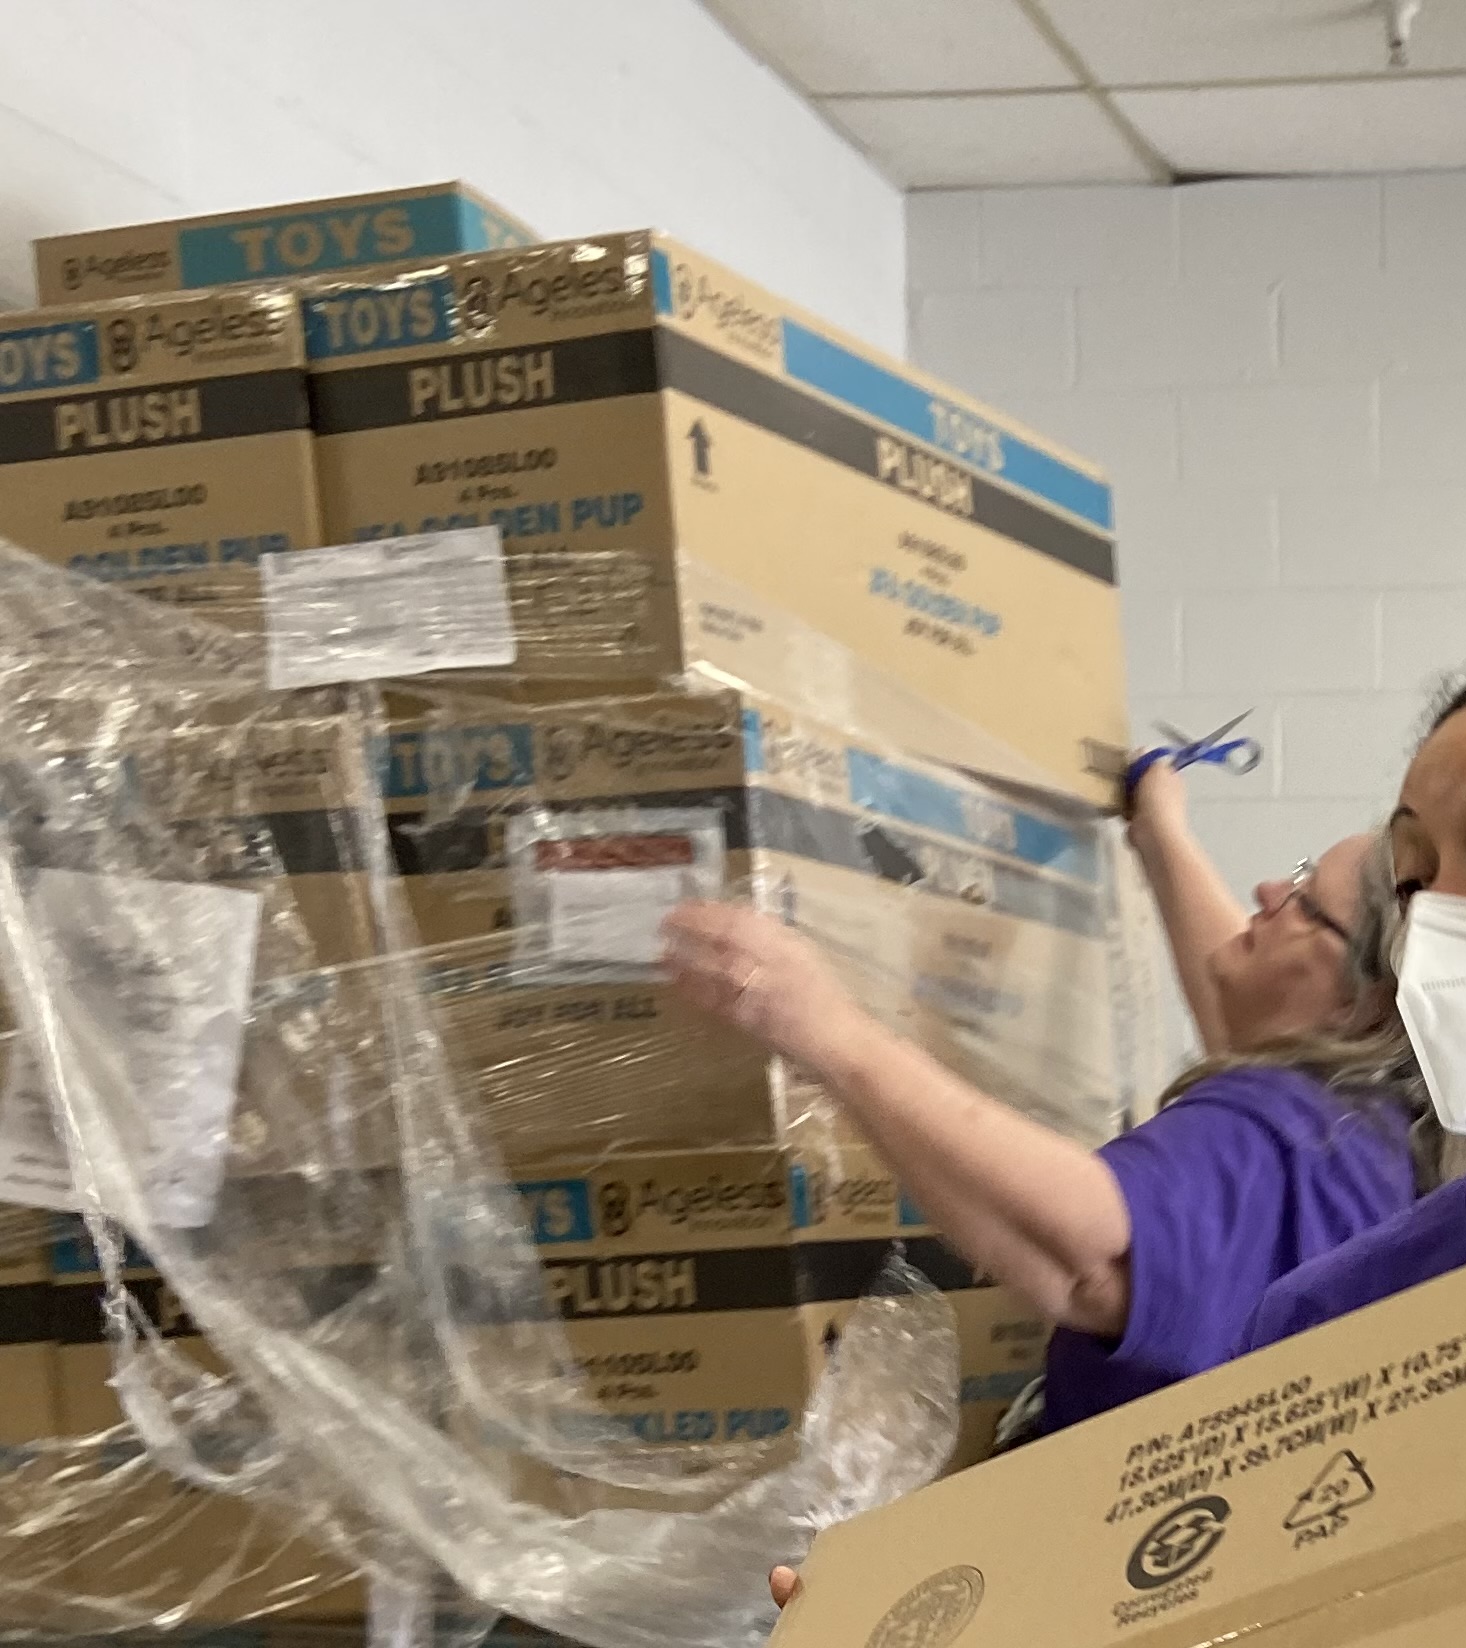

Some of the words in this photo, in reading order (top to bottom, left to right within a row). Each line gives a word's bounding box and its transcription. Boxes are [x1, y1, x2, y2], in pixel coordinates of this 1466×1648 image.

[230, 206, 415, 273] TOYS
[320, 288, 437, 348] TOYS
[409, 349, 555, 418] PLUSH
[55, 387, 201, 451] PLUSH
[573, 492, 644, 529] PUP
[388, 733, 515, 790] TOYS
